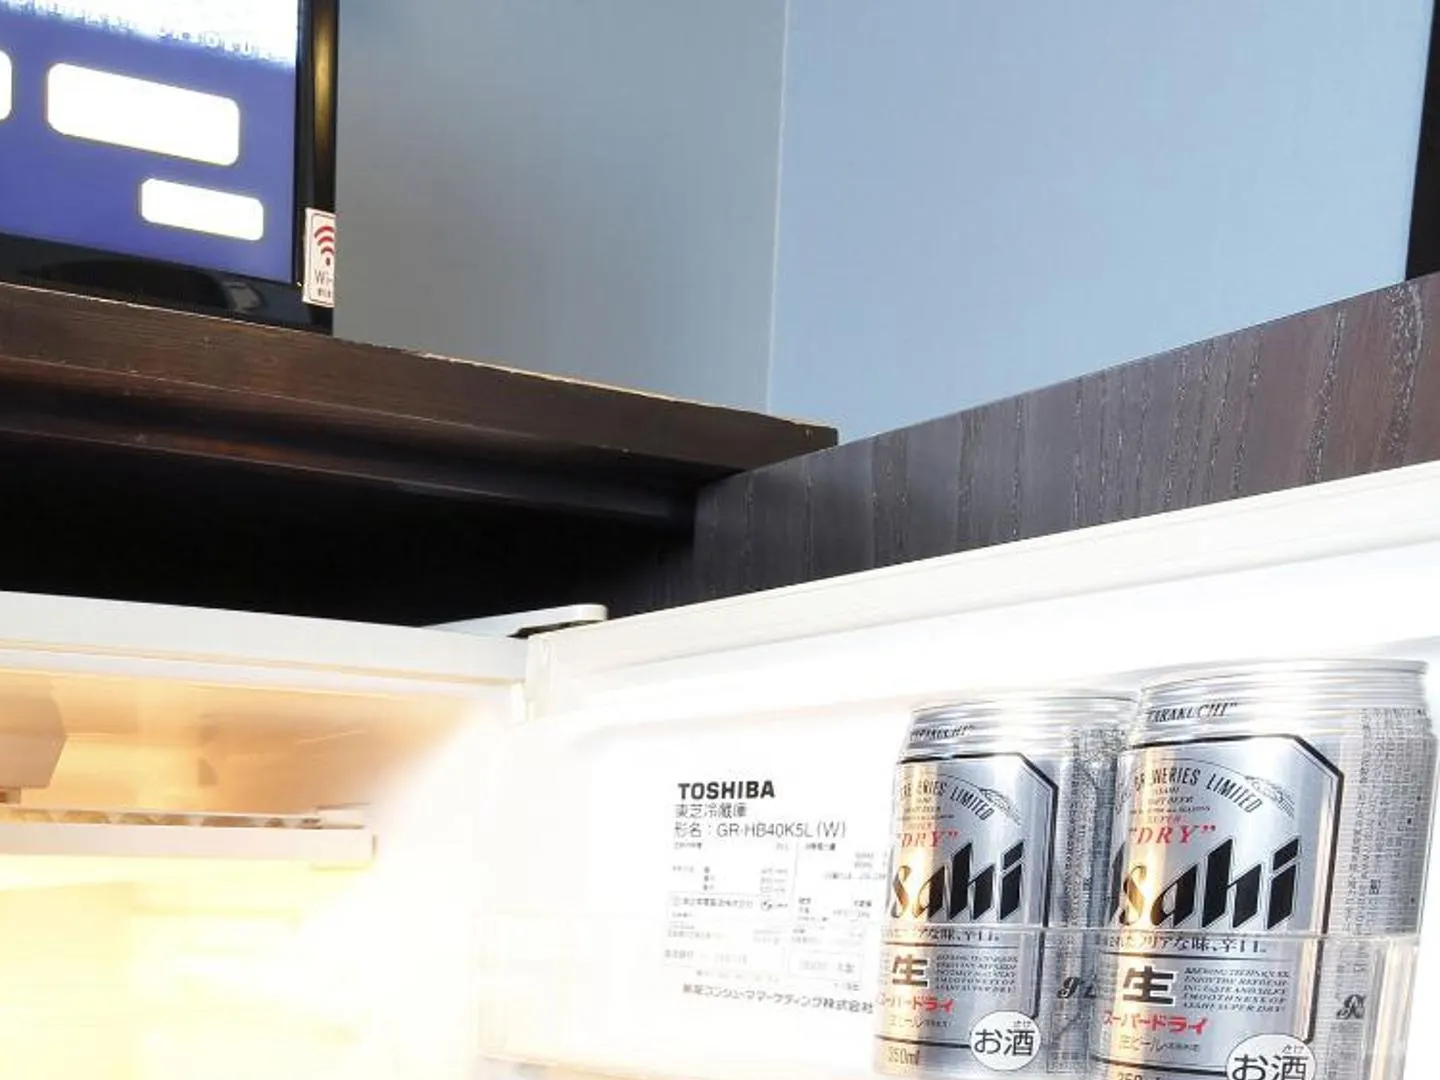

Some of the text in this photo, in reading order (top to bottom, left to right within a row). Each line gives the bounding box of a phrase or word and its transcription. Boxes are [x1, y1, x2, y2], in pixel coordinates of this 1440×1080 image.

[677, 780, 776, 800] TOSHIBA
[949, 785, 996, 821] LIMITED
[1205, 772, 1264, 814] LIMITED
[675, 802, 748, 820] 東芝冷蔵庫
[889, 841, 1025, 921] sahi
[891, 952, 930, 989] 生
[1122, 963, 1176, 1006] 生
[973, 1027, 1037, 1058] お酒
